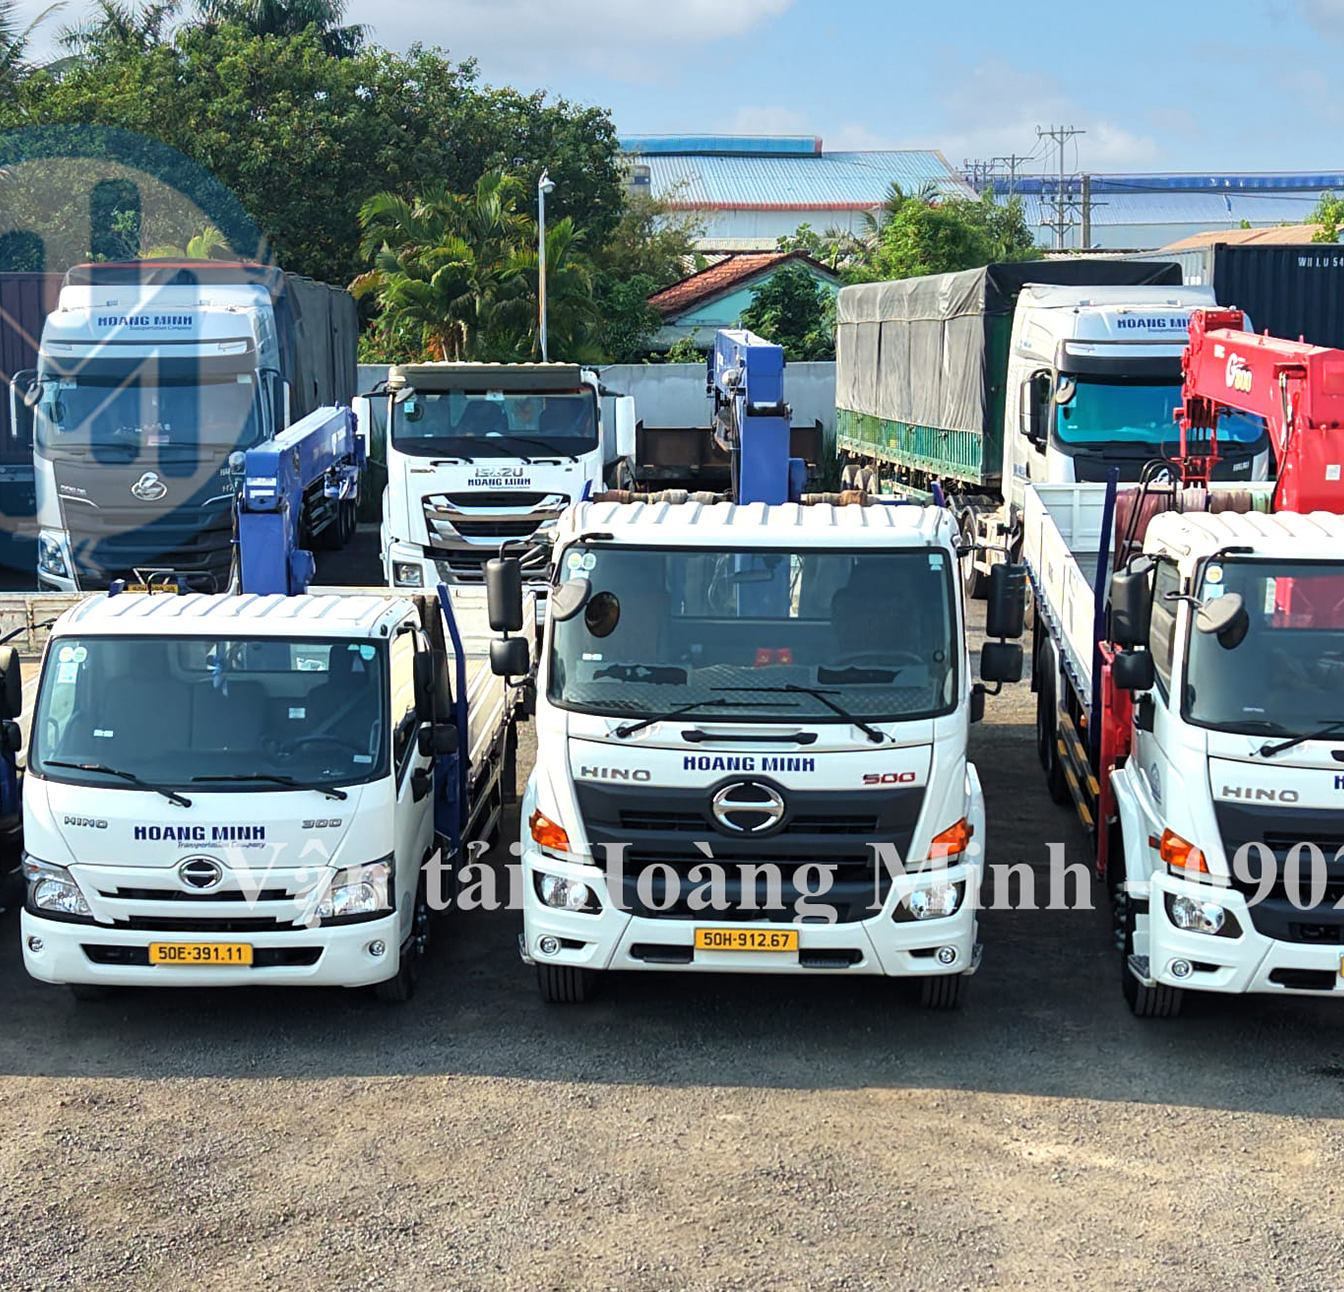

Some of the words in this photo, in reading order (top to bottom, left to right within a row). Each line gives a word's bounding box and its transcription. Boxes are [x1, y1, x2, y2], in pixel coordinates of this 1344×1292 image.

[98, 316, 150, 326] HOANG
[154, 316, 193, 325] MINH
[1117, 318, 1166, 329] HOANG
[467, 478, 503, 487] HOANG
[683, 756, 755, 772] HOANG
[762, 757, 815, 772] MINH
[581, 765, 651, 782] HINO
[862, 772, 916, 785] 500
[1222, 785, 1299, 802] HINO
[64, 815, 108, 828] HINO
[301, 818, 343, 829] 300
[134, 825, 205, 840] HOANG
[211, 825, 266, 841] MINH
[703, 932, 789, 948] 50H-912.67
[158, 947, 243, 961] 50E-391.11
